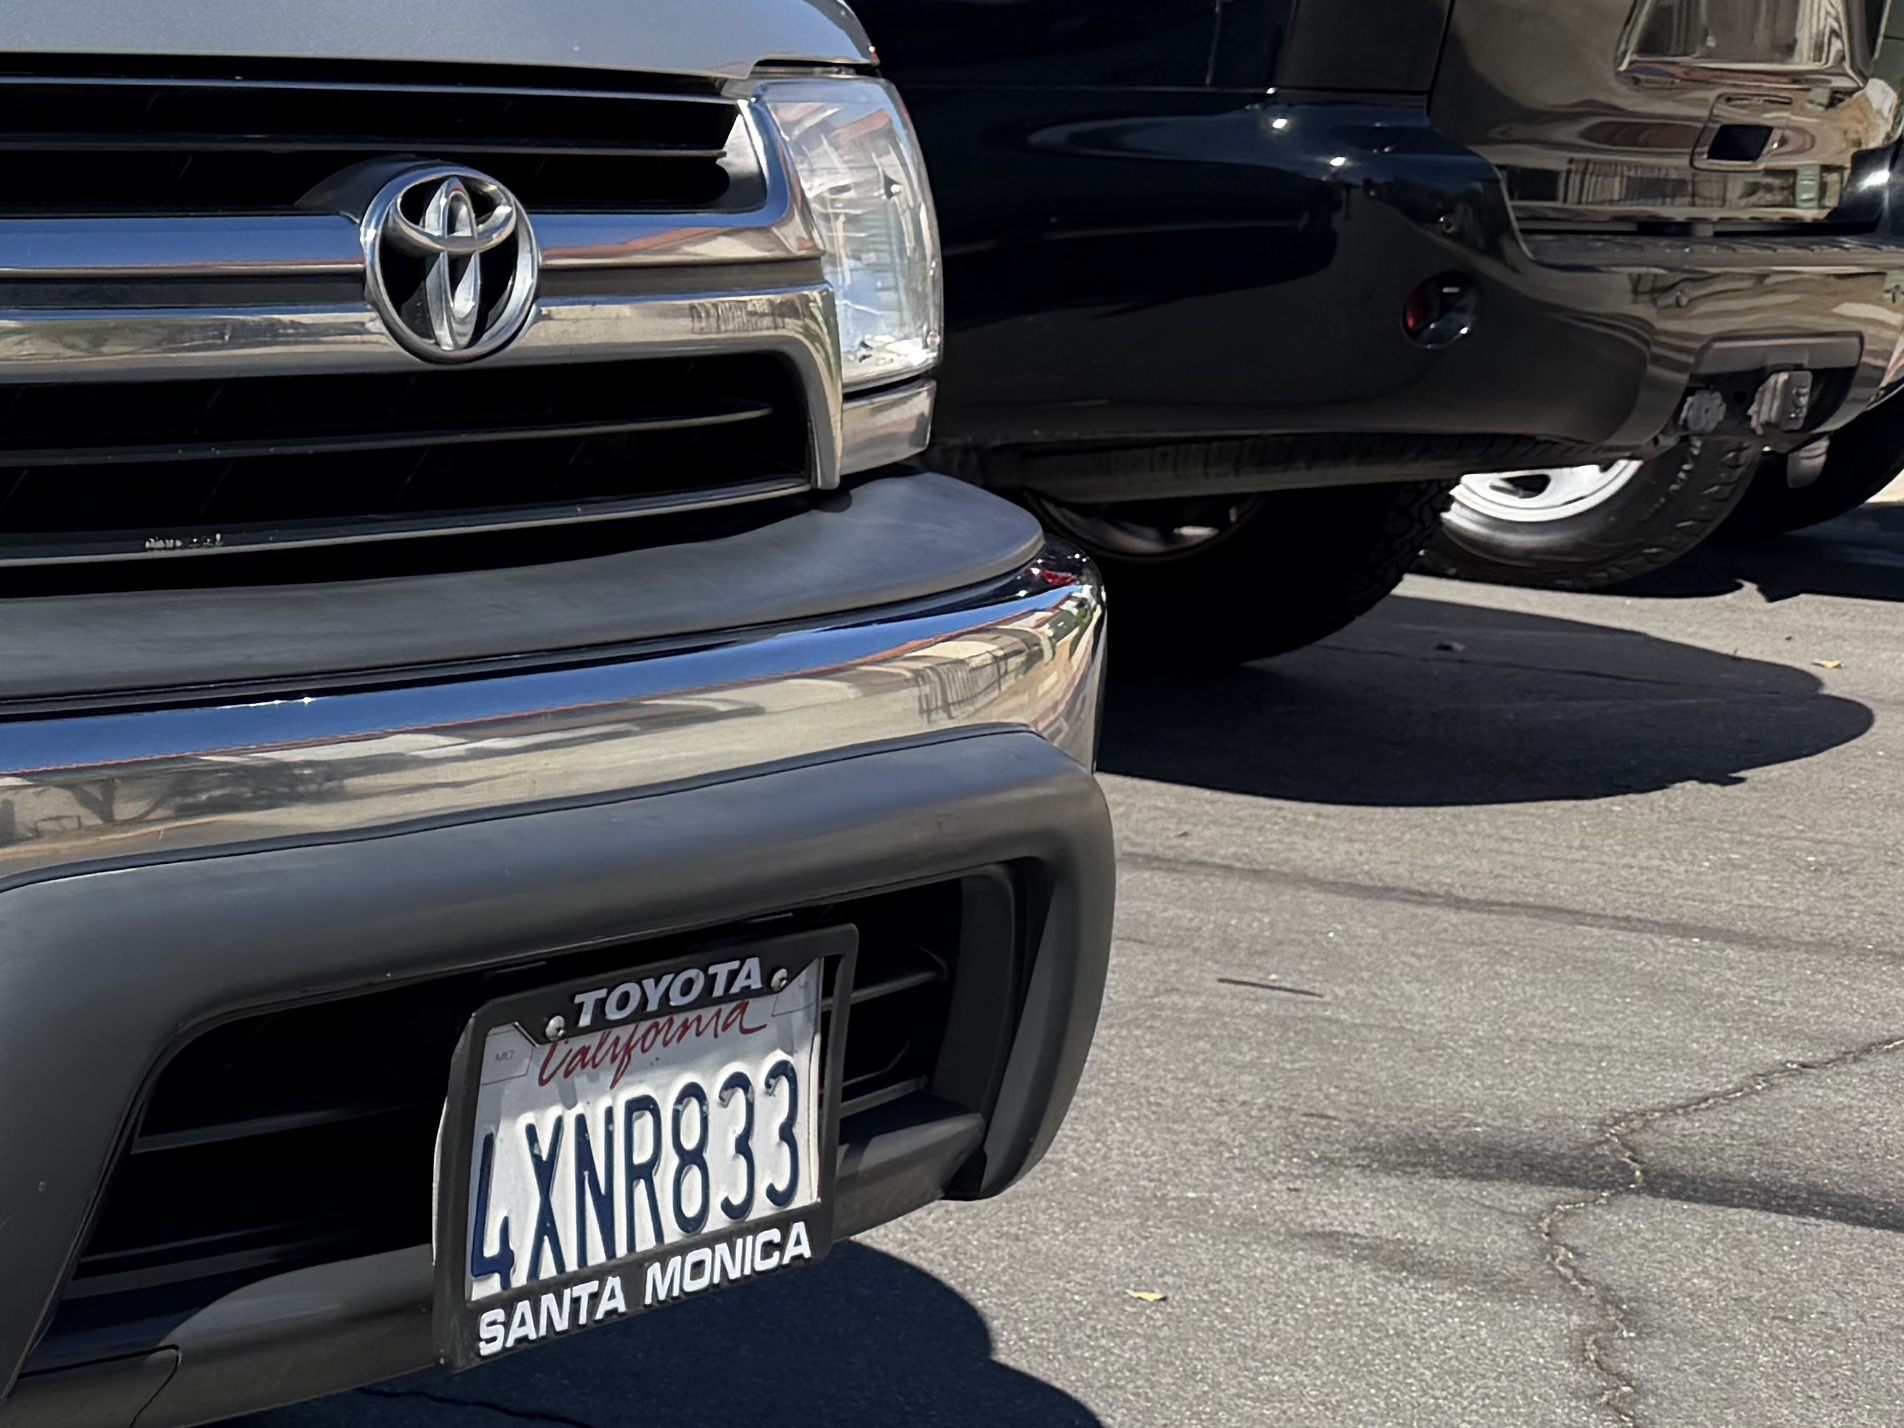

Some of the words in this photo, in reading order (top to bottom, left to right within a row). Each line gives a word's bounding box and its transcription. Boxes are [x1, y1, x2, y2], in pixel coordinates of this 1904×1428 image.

[538, 1000, 768, 1090] California
[574, 956, 765, 1028] TOYOTA
[469, 1058, 800, 1292] 4XNR833
[477, 1274, 629, 1358] SANTA
[642, 1221, 813, 1308] MONICA
